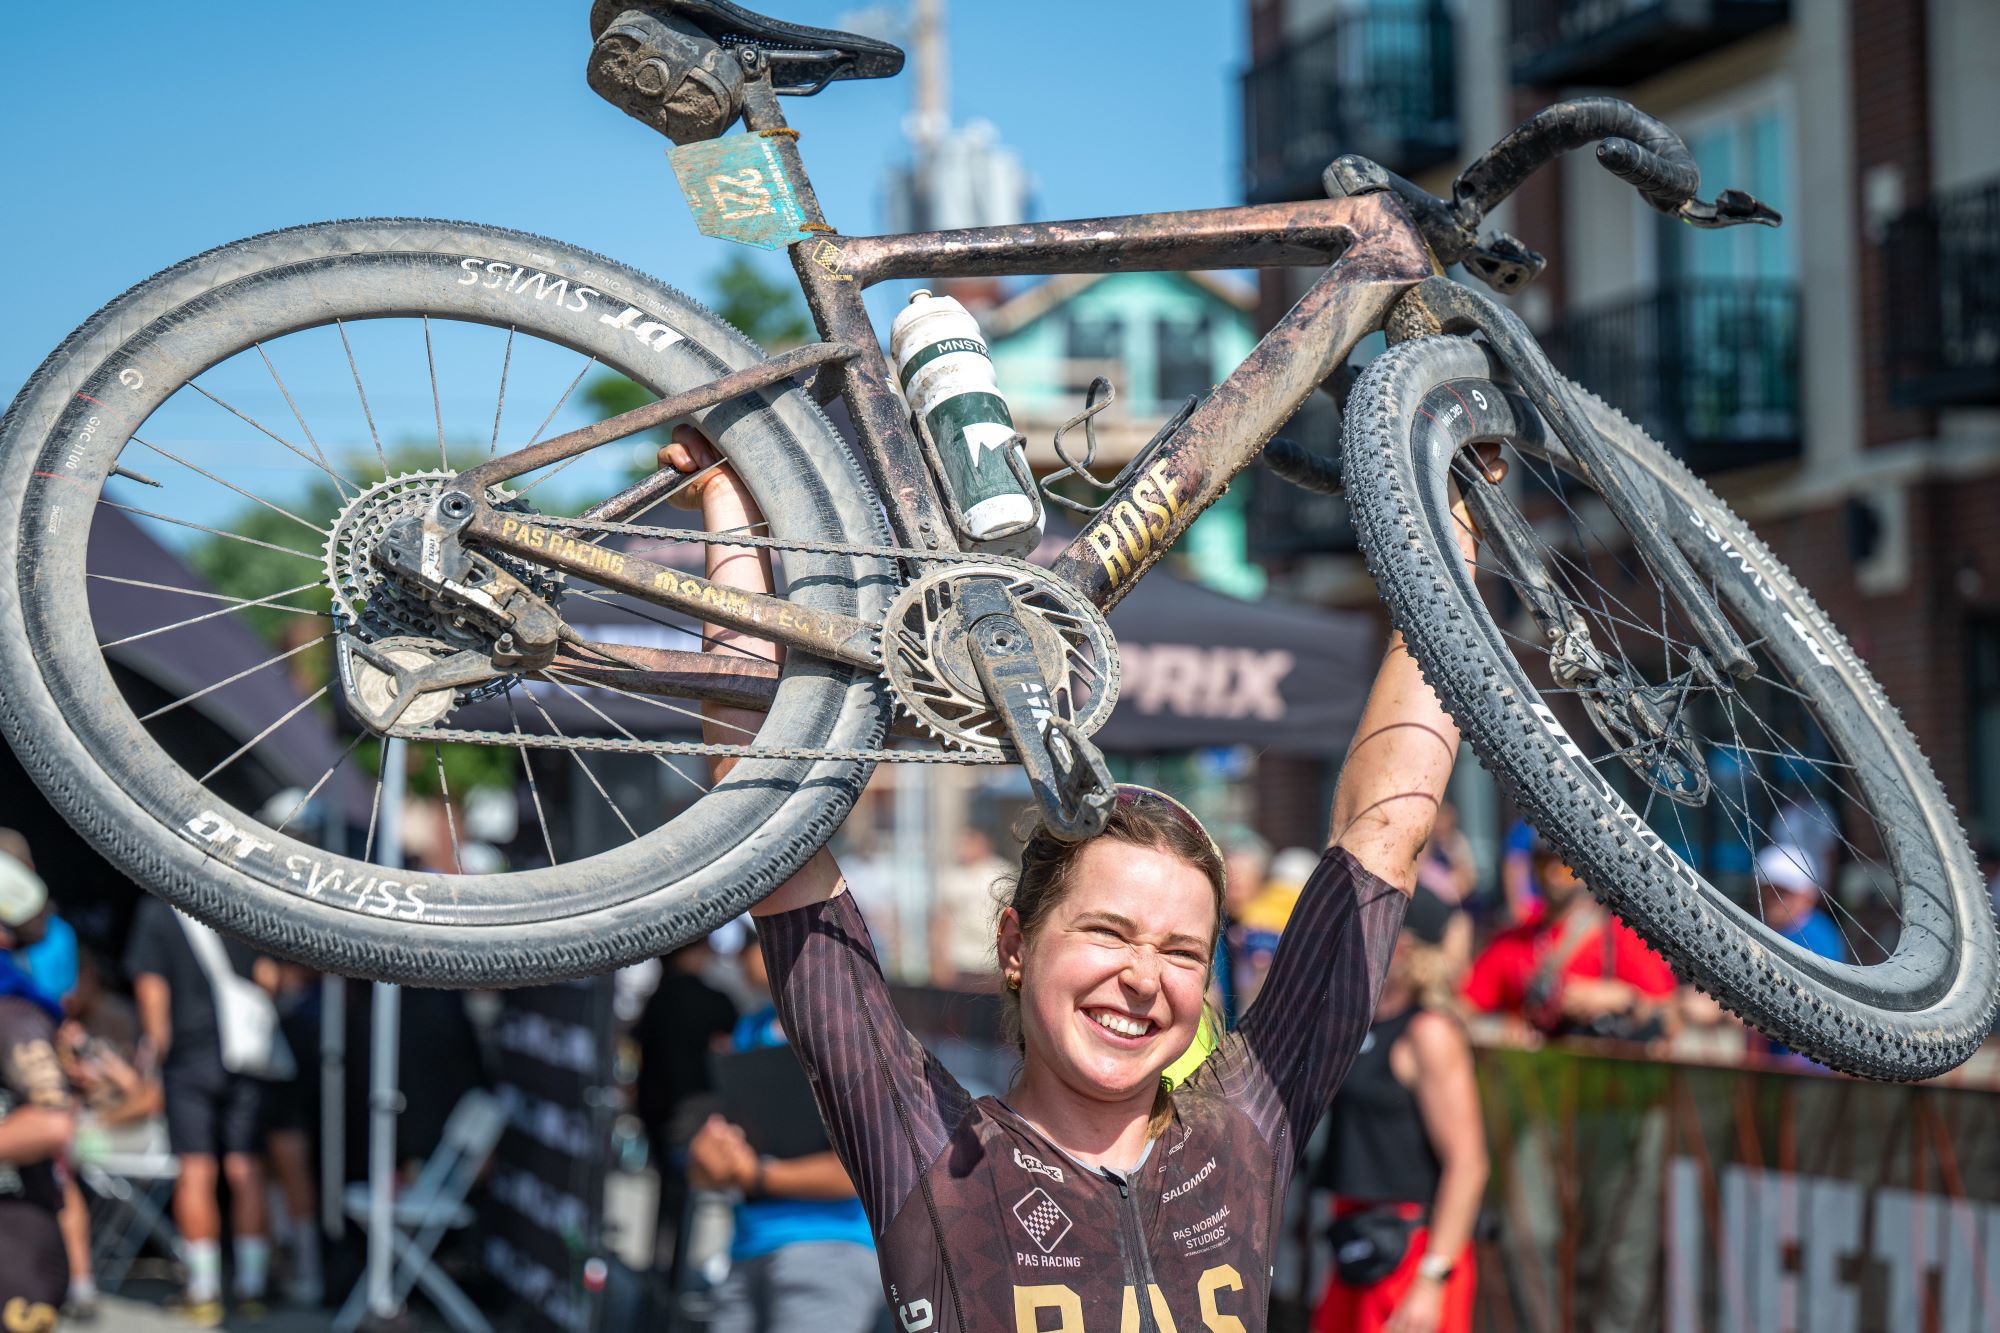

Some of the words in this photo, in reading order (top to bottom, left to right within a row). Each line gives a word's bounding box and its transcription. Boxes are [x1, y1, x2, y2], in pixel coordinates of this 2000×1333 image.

[458, 259, 600, 312] SWISS
[599, 307, 685, 353] DT
[80, 416, 101, 442] GRC
[66, 443, 86, 470] 1100
[1087, 458, 1189, 588] ROSE
[502, 518, 544, 549] PAS
[548, 533, 625, 575] RACING
[1795, 596, 1886, 710] THUNDER
[1601, 780, 1700, 892] SWISS
[1162, 1157, 1217, 1204] SALOMON
[1173, 1226, 1192, 1241] PAS
[1192, 1205, 1230, 1234] NORMAL
[1186, 1224, 1226, 1249] STUDIOS
[1017, 1252, 1039, 1267] PAS
[1041, 1255, 1082, 1268] RACING
